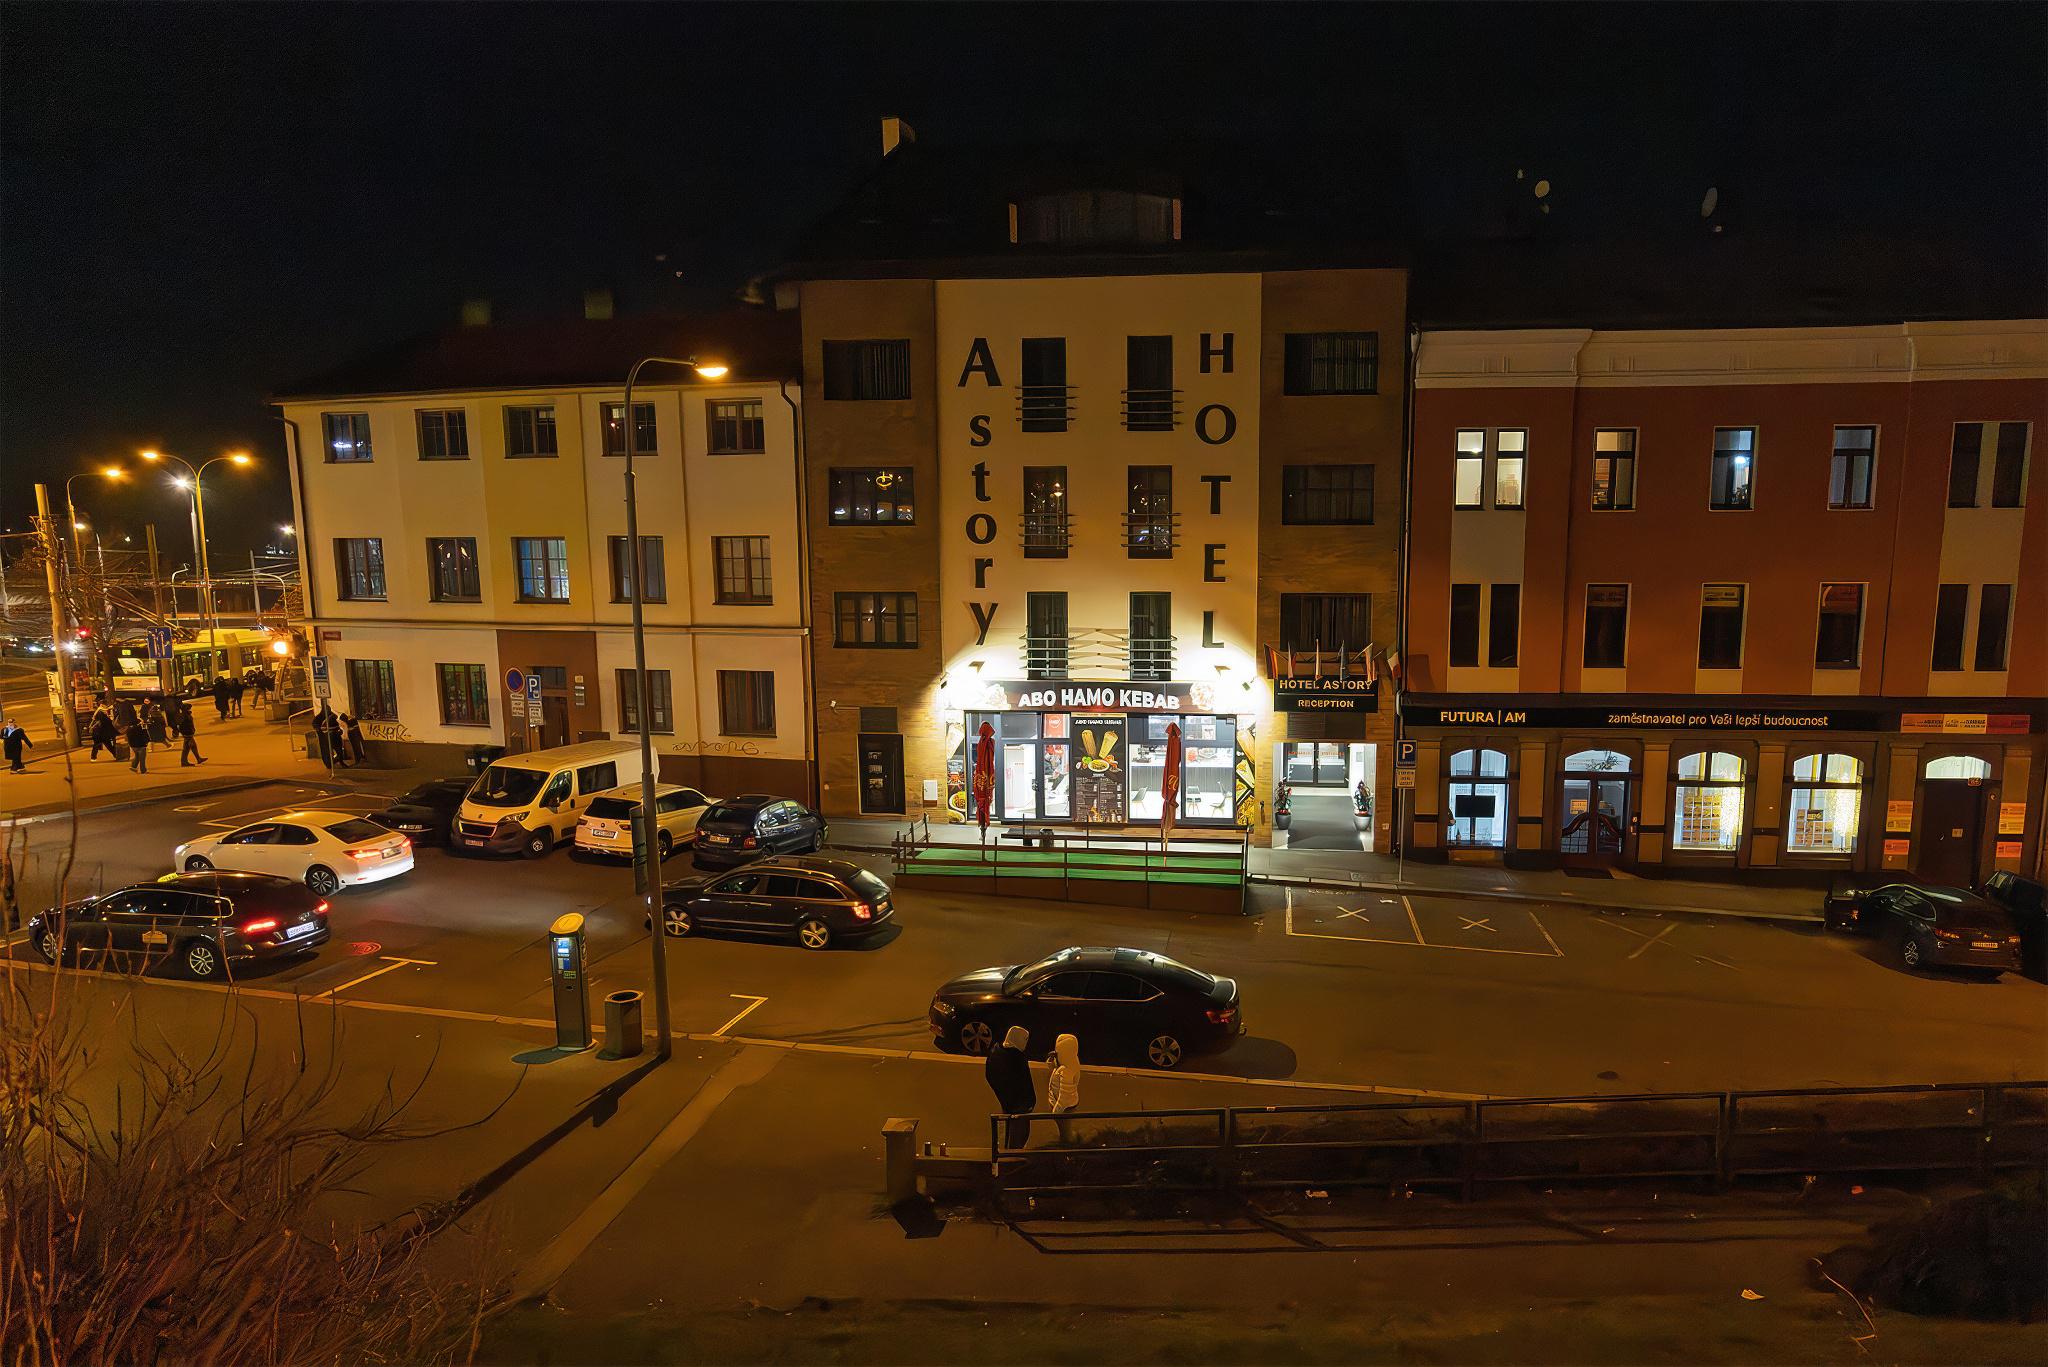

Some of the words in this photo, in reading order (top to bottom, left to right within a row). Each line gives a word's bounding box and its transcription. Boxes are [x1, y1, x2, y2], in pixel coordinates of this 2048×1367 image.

[957, 337, 1002, 646] Astory
[1195, 333, 1237, 648] HOTEL
[314, 659, 324, 673] P
[529, 678, 538, 692] P
[1279, 680, 1319, 690] HOTEL
[1322, 680, 1373, 690] ASTORY
[1018, 690, 1057, 707] ABO
[1061, 687, 1115, 707] HAMO
[1119, 689, 1180, 710] KEBAB
[1298, 699, 1354, 708] RECEPTION
[1440, 711, 1495, 723] FUTURA
[1504, 711, 1526, 723] AM
[1689, 716, 1707, 726] pro
[1764, 715, 1829, 726] budoucnost
[1402, 743, 1414, 760] P
